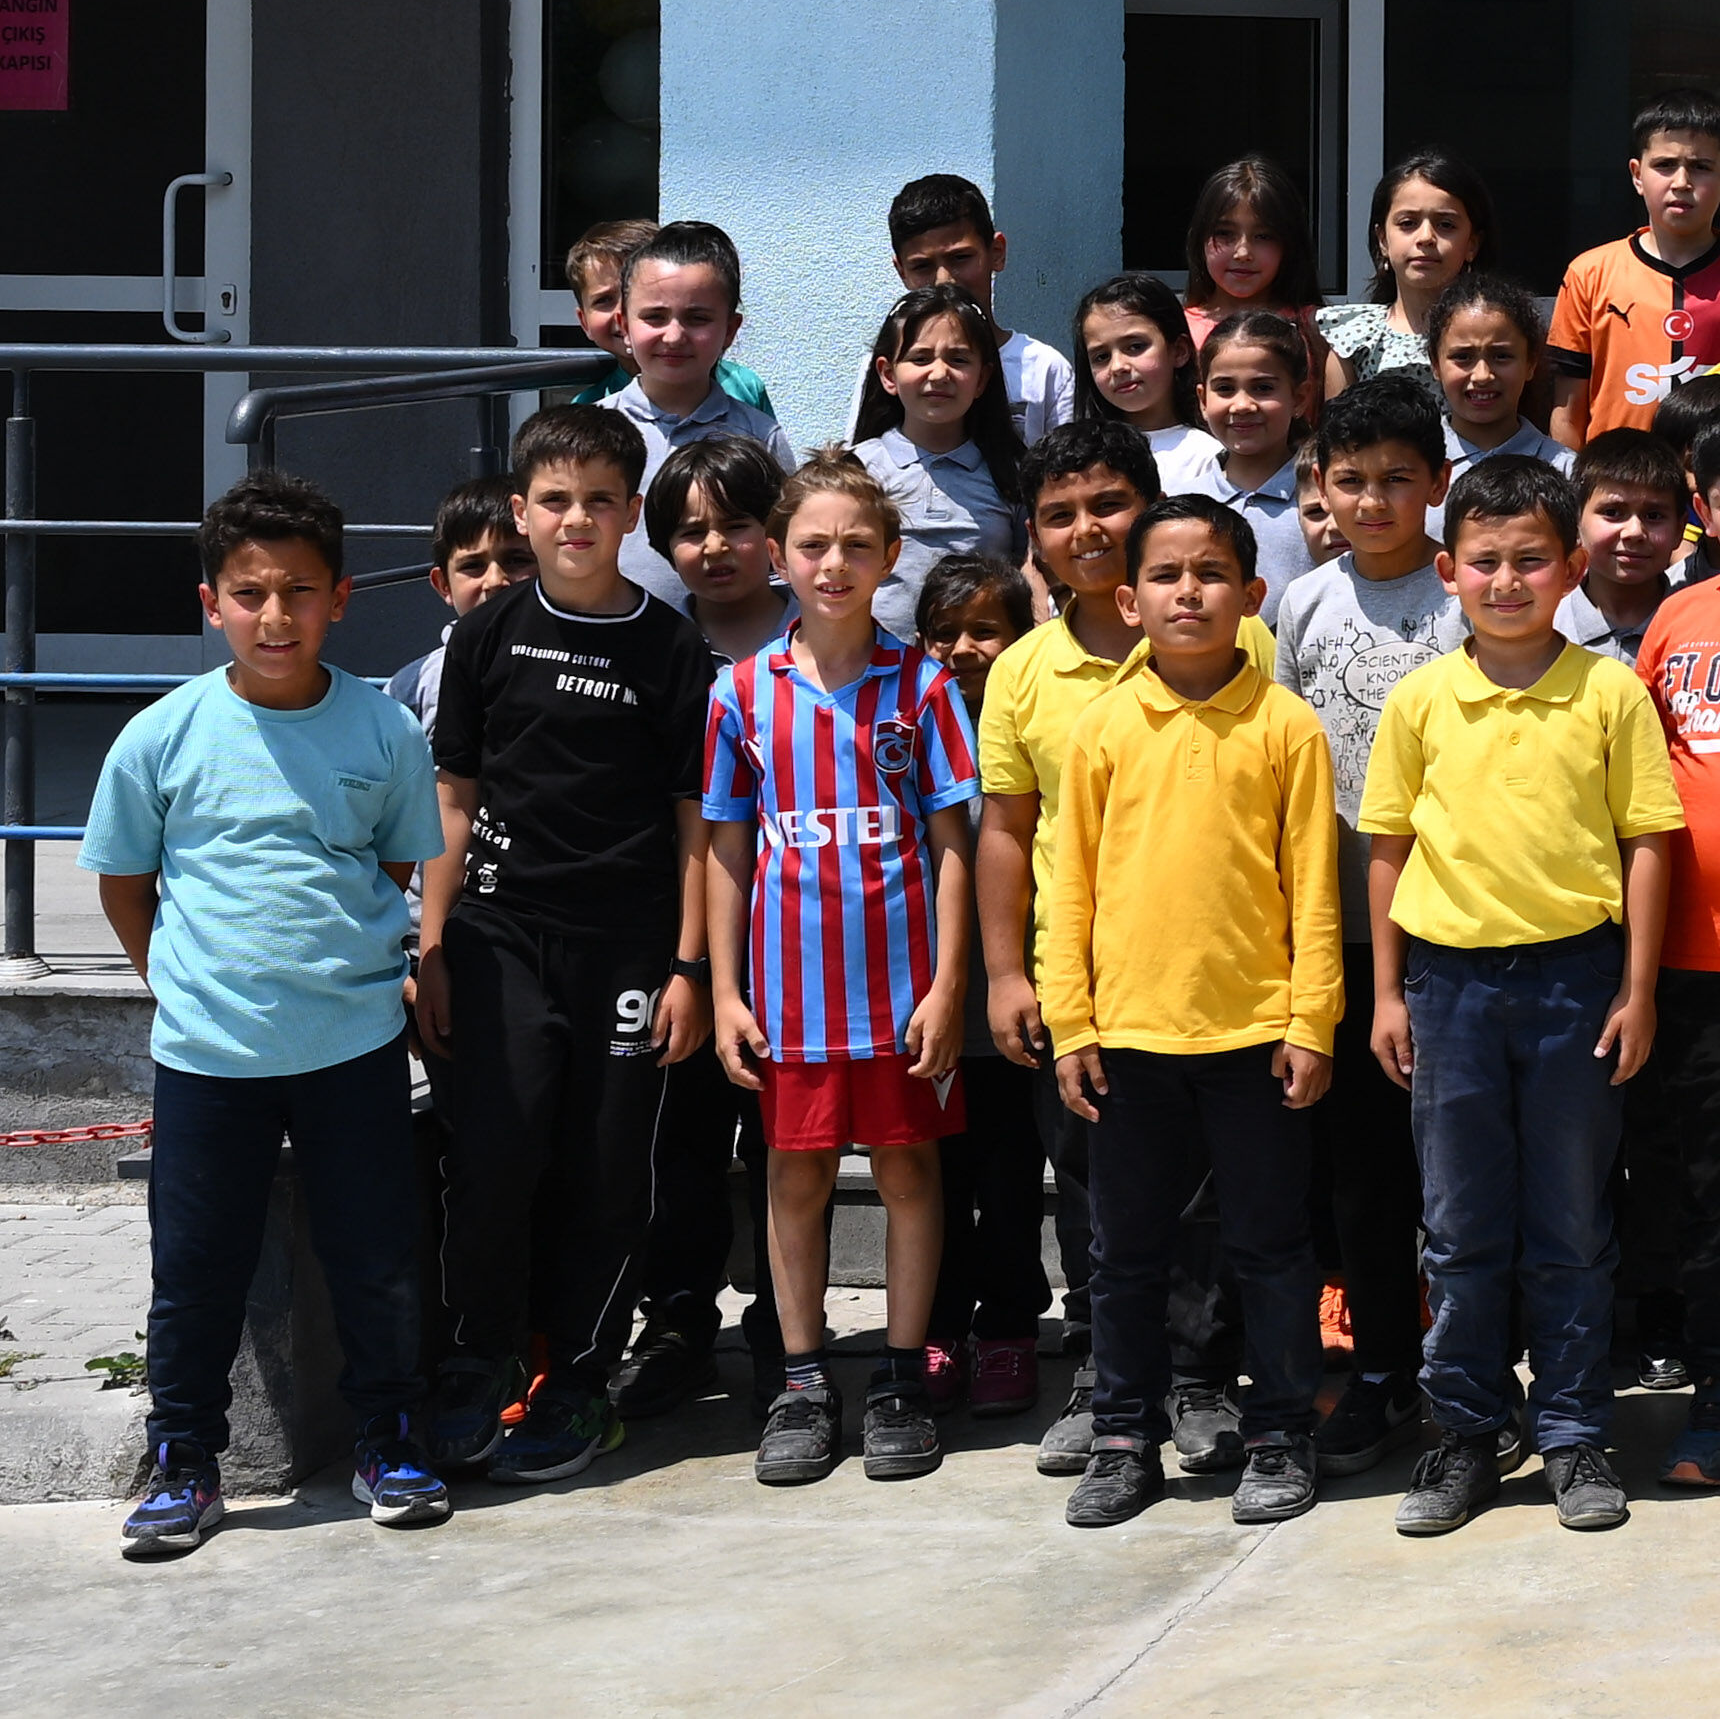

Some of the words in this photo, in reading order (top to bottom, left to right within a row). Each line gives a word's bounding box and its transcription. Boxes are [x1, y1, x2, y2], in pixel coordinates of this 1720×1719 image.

[2, 26, 46, 45] ÇIKIŞ
[556, 673, 620, 701] DETROIT
[1358, 687, 1386, 702] THE
[761, 804, 904, 849] VESTEL
